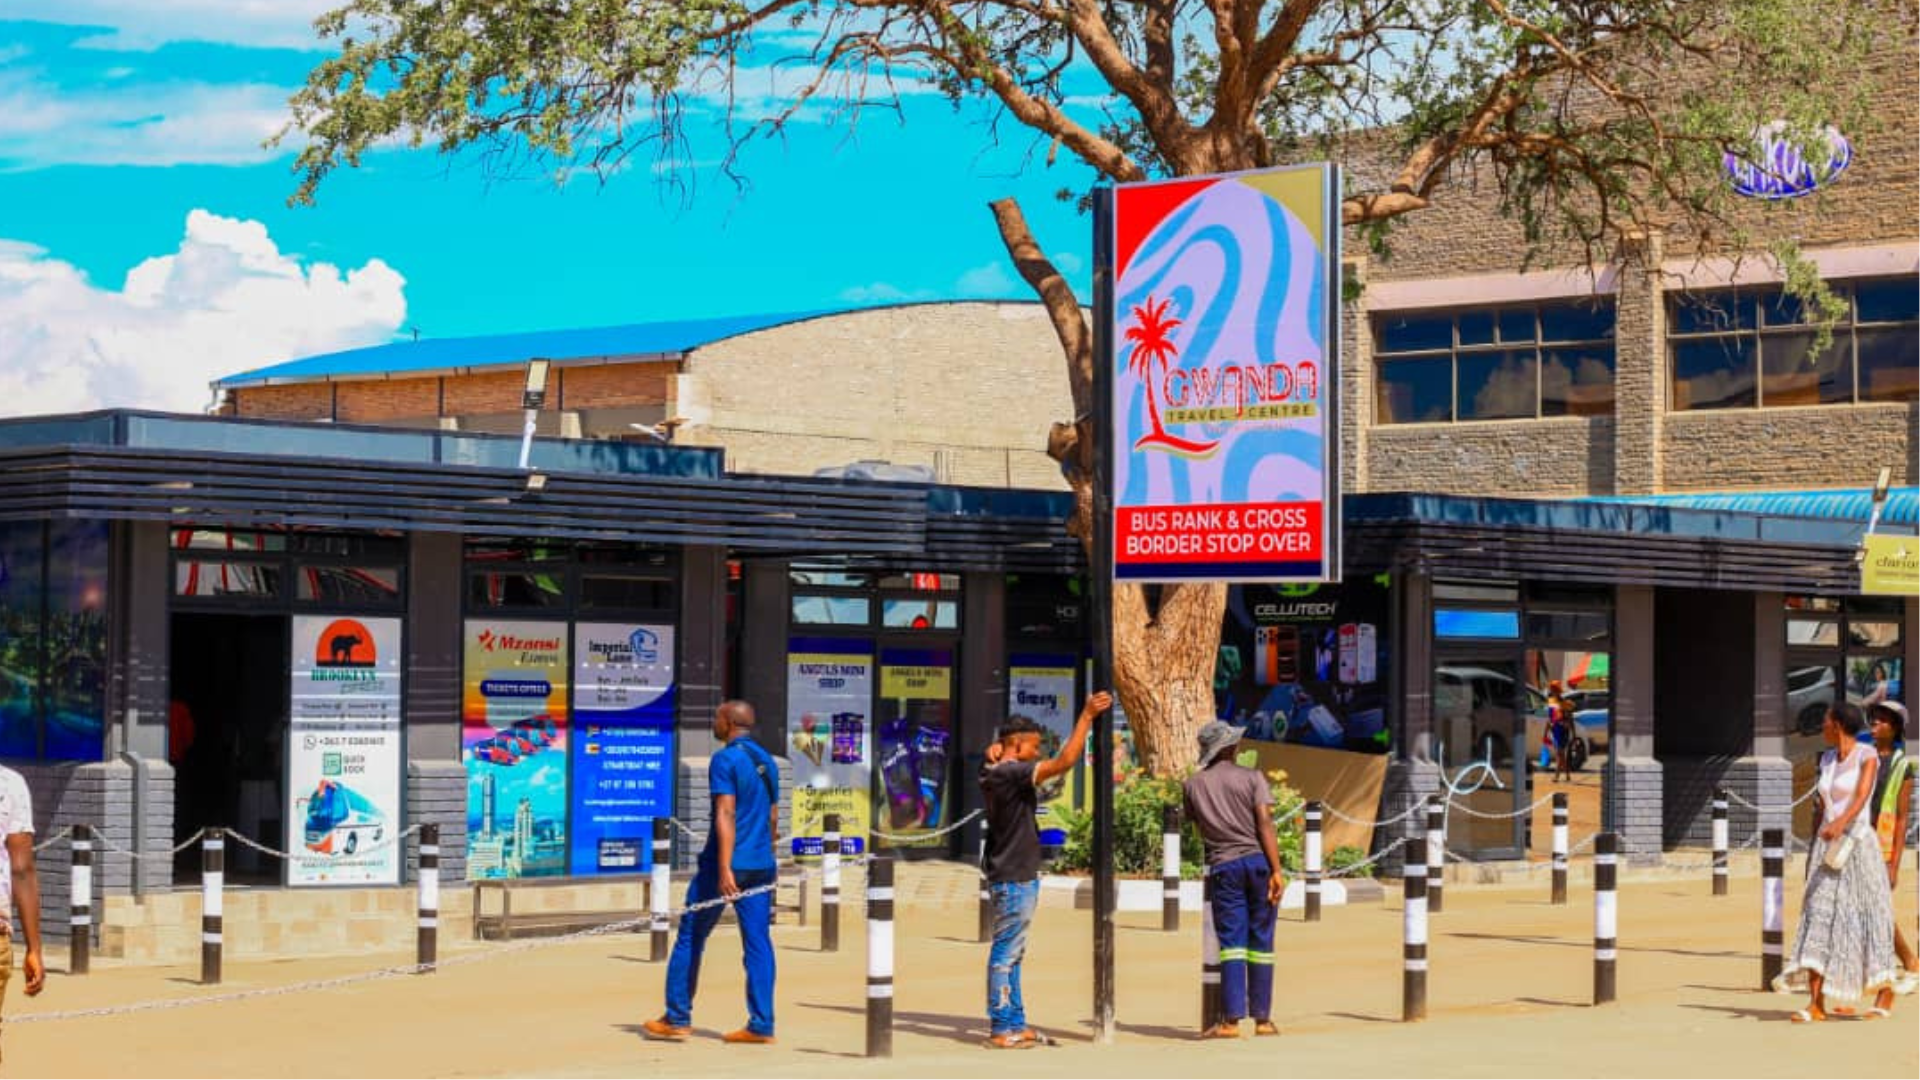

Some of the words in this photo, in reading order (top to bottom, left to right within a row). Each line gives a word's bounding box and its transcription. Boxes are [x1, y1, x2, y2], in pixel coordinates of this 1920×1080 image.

[1164, 361, 1318, 417] GWANDA
[1168, 408, 1226, 423] TRAVEL
[1248, 404, 1311, 419] CENTRE
[1131, 512, 1167, 532] BUS
[1171, 510, 1222, 530] RANK
[1226, 510, 1240, 529] &
[1244, 508, 1307, 529] CROSS
[1126, 534, 1203, 555] BORDER
[1203, 533, 1255, 554] STOP
[1258, 532, 1312, 553] OVER
[1254, 602, 1336, 616] CELLUTECH
[500, 634, 561, 652] Mzansi
